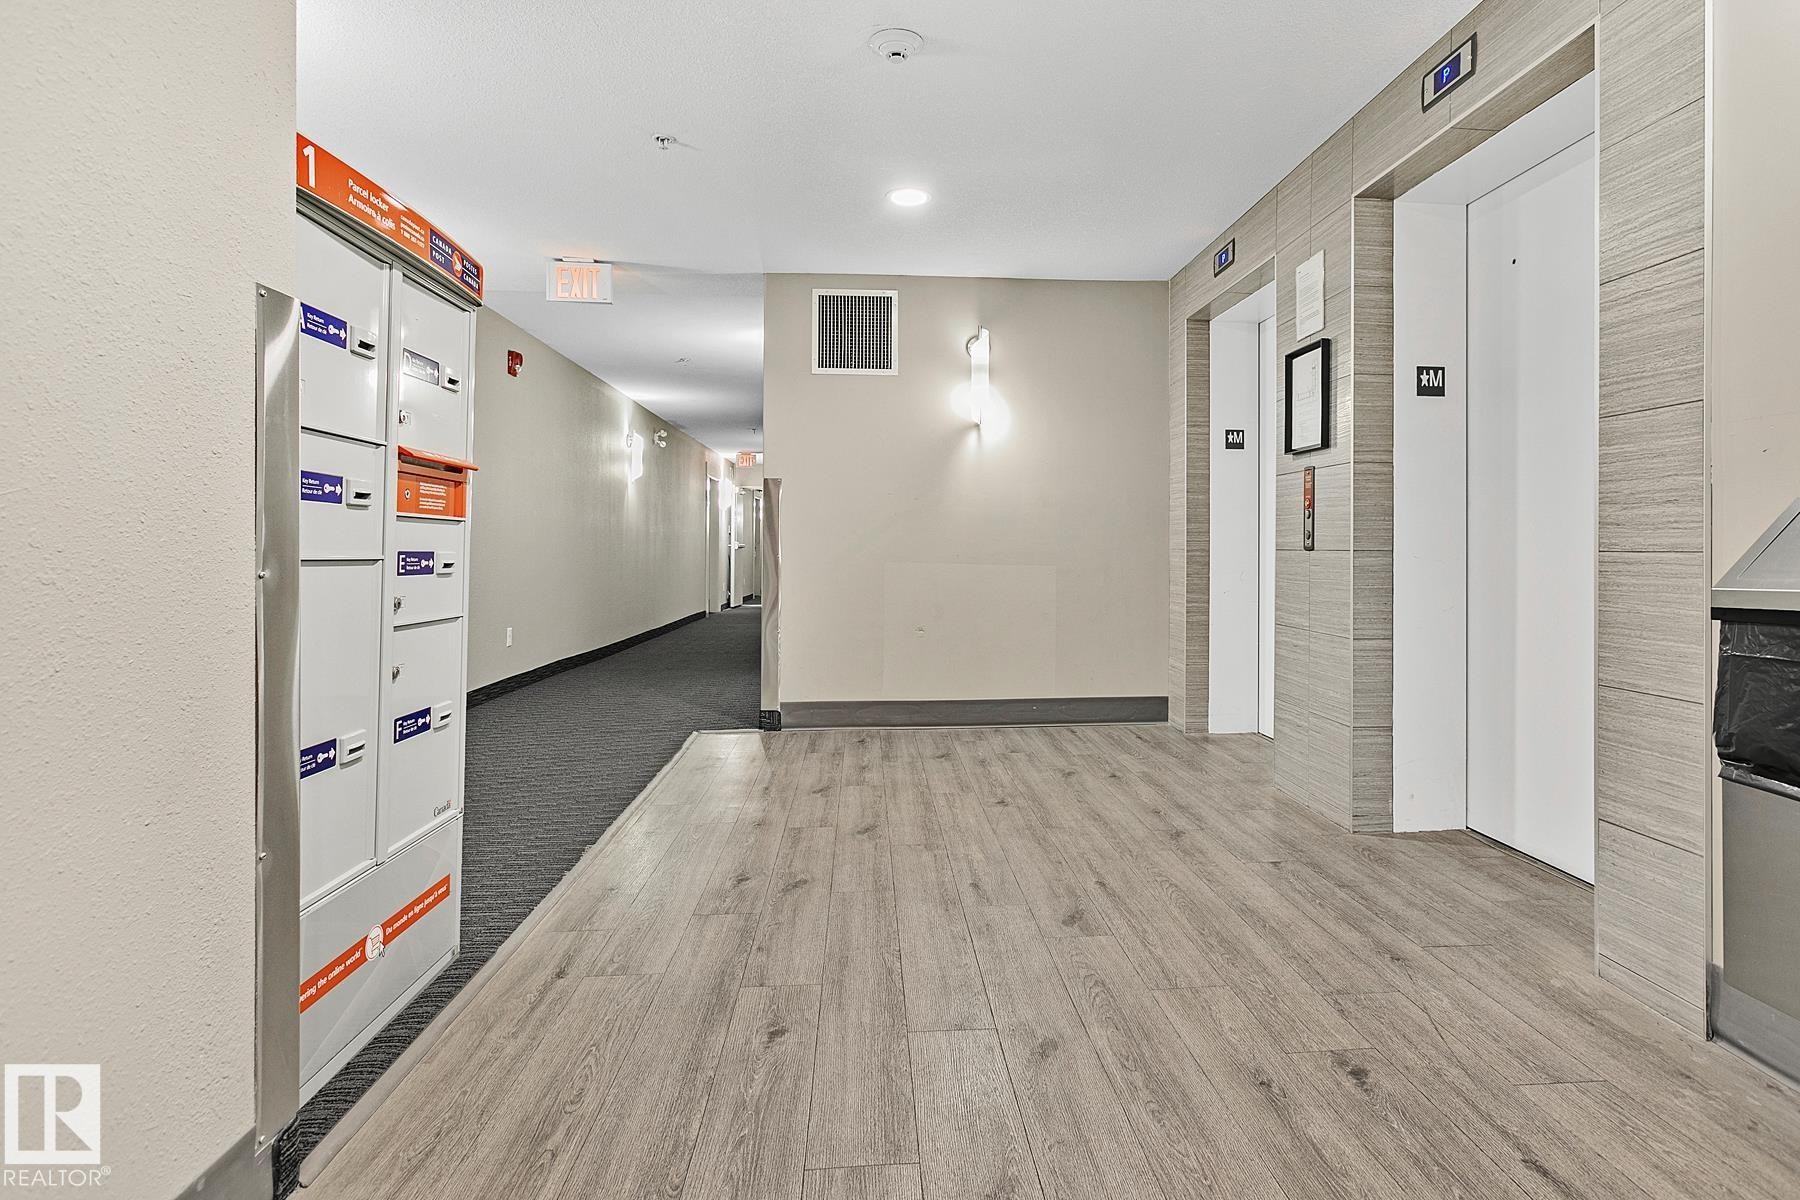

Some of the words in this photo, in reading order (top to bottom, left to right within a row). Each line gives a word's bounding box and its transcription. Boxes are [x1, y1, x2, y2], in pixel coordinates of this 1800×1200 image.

[1442, 66, 1451, 84] P
[303, 145, 316, 189] 1
[348, 178, 369, 200] Parcel
[369, 191, 389, 212] locker
[348, 193, 376, 218] Armoire
[381, 217, 396, 231] colis
[432, 235, 452, 255] CANADA
[432, 249, 445, 264] POST
[463, 259, 478, 276] POSTES
[463, 273, 479, 290] CANADA
[556, 265, 600, 299] EXIT
[738, 454, 753, 467] EXIT
[399, 554, 405, 573] E
[396, 720, 402, 740] F
[433, 800, 451, 817] Canada
[385, 926, 393, 936] Du
[392, 914, 408, 930] monde
[408, 910, 414, 919] en
[413, 902, 424, 914] ligne
[317, 976, 328, 989] the
[327, 963, 346, 981] online
